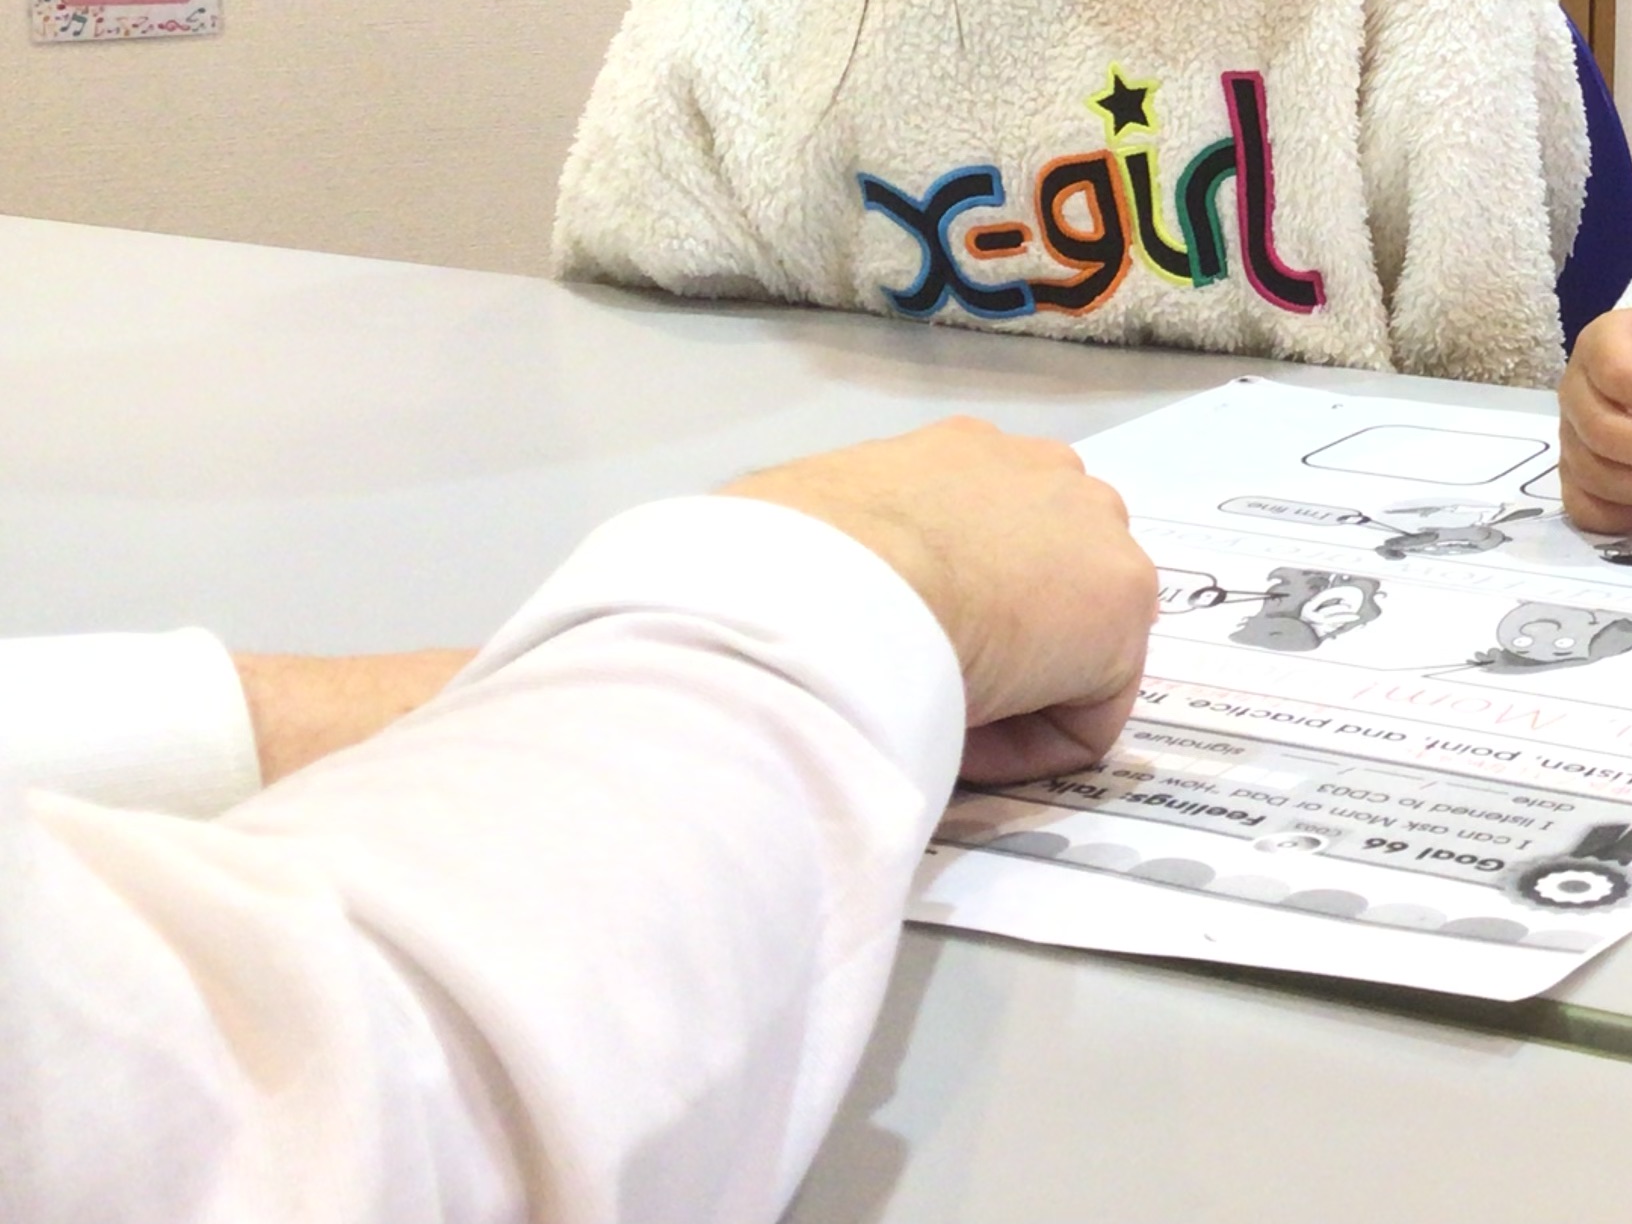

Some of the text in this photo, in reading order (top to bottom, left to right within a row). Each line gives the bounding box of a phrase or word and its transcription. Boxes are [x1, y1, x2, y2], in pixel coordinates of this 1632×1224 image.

[1185, 696, 1334, 730] practice.
[1351, 680, 1569, 731] Mom!
[1334, 722, 1408, 743] and
[1424, 735, 1523, 762] point,
[1111, 768, 1156, 782] are
[1132, 730, 1577, 813] date signature
[1229, 787, 1291, 807] Dad
[1292, 799, 1323, 812] or
[1315, 782, 1556, 832] I listened to CD03
[1119, 791, 1268, 827] Feelings:
[1330, 806, 1398, 829] Mom
[1405, 820, 1450, 836] ask
[1456, 828, 1512, 845] can
[1361, 837, 1411, 854] 66
[1514, 838, 1534, 852] I
[1415, 846, 1506, 873] Goal
